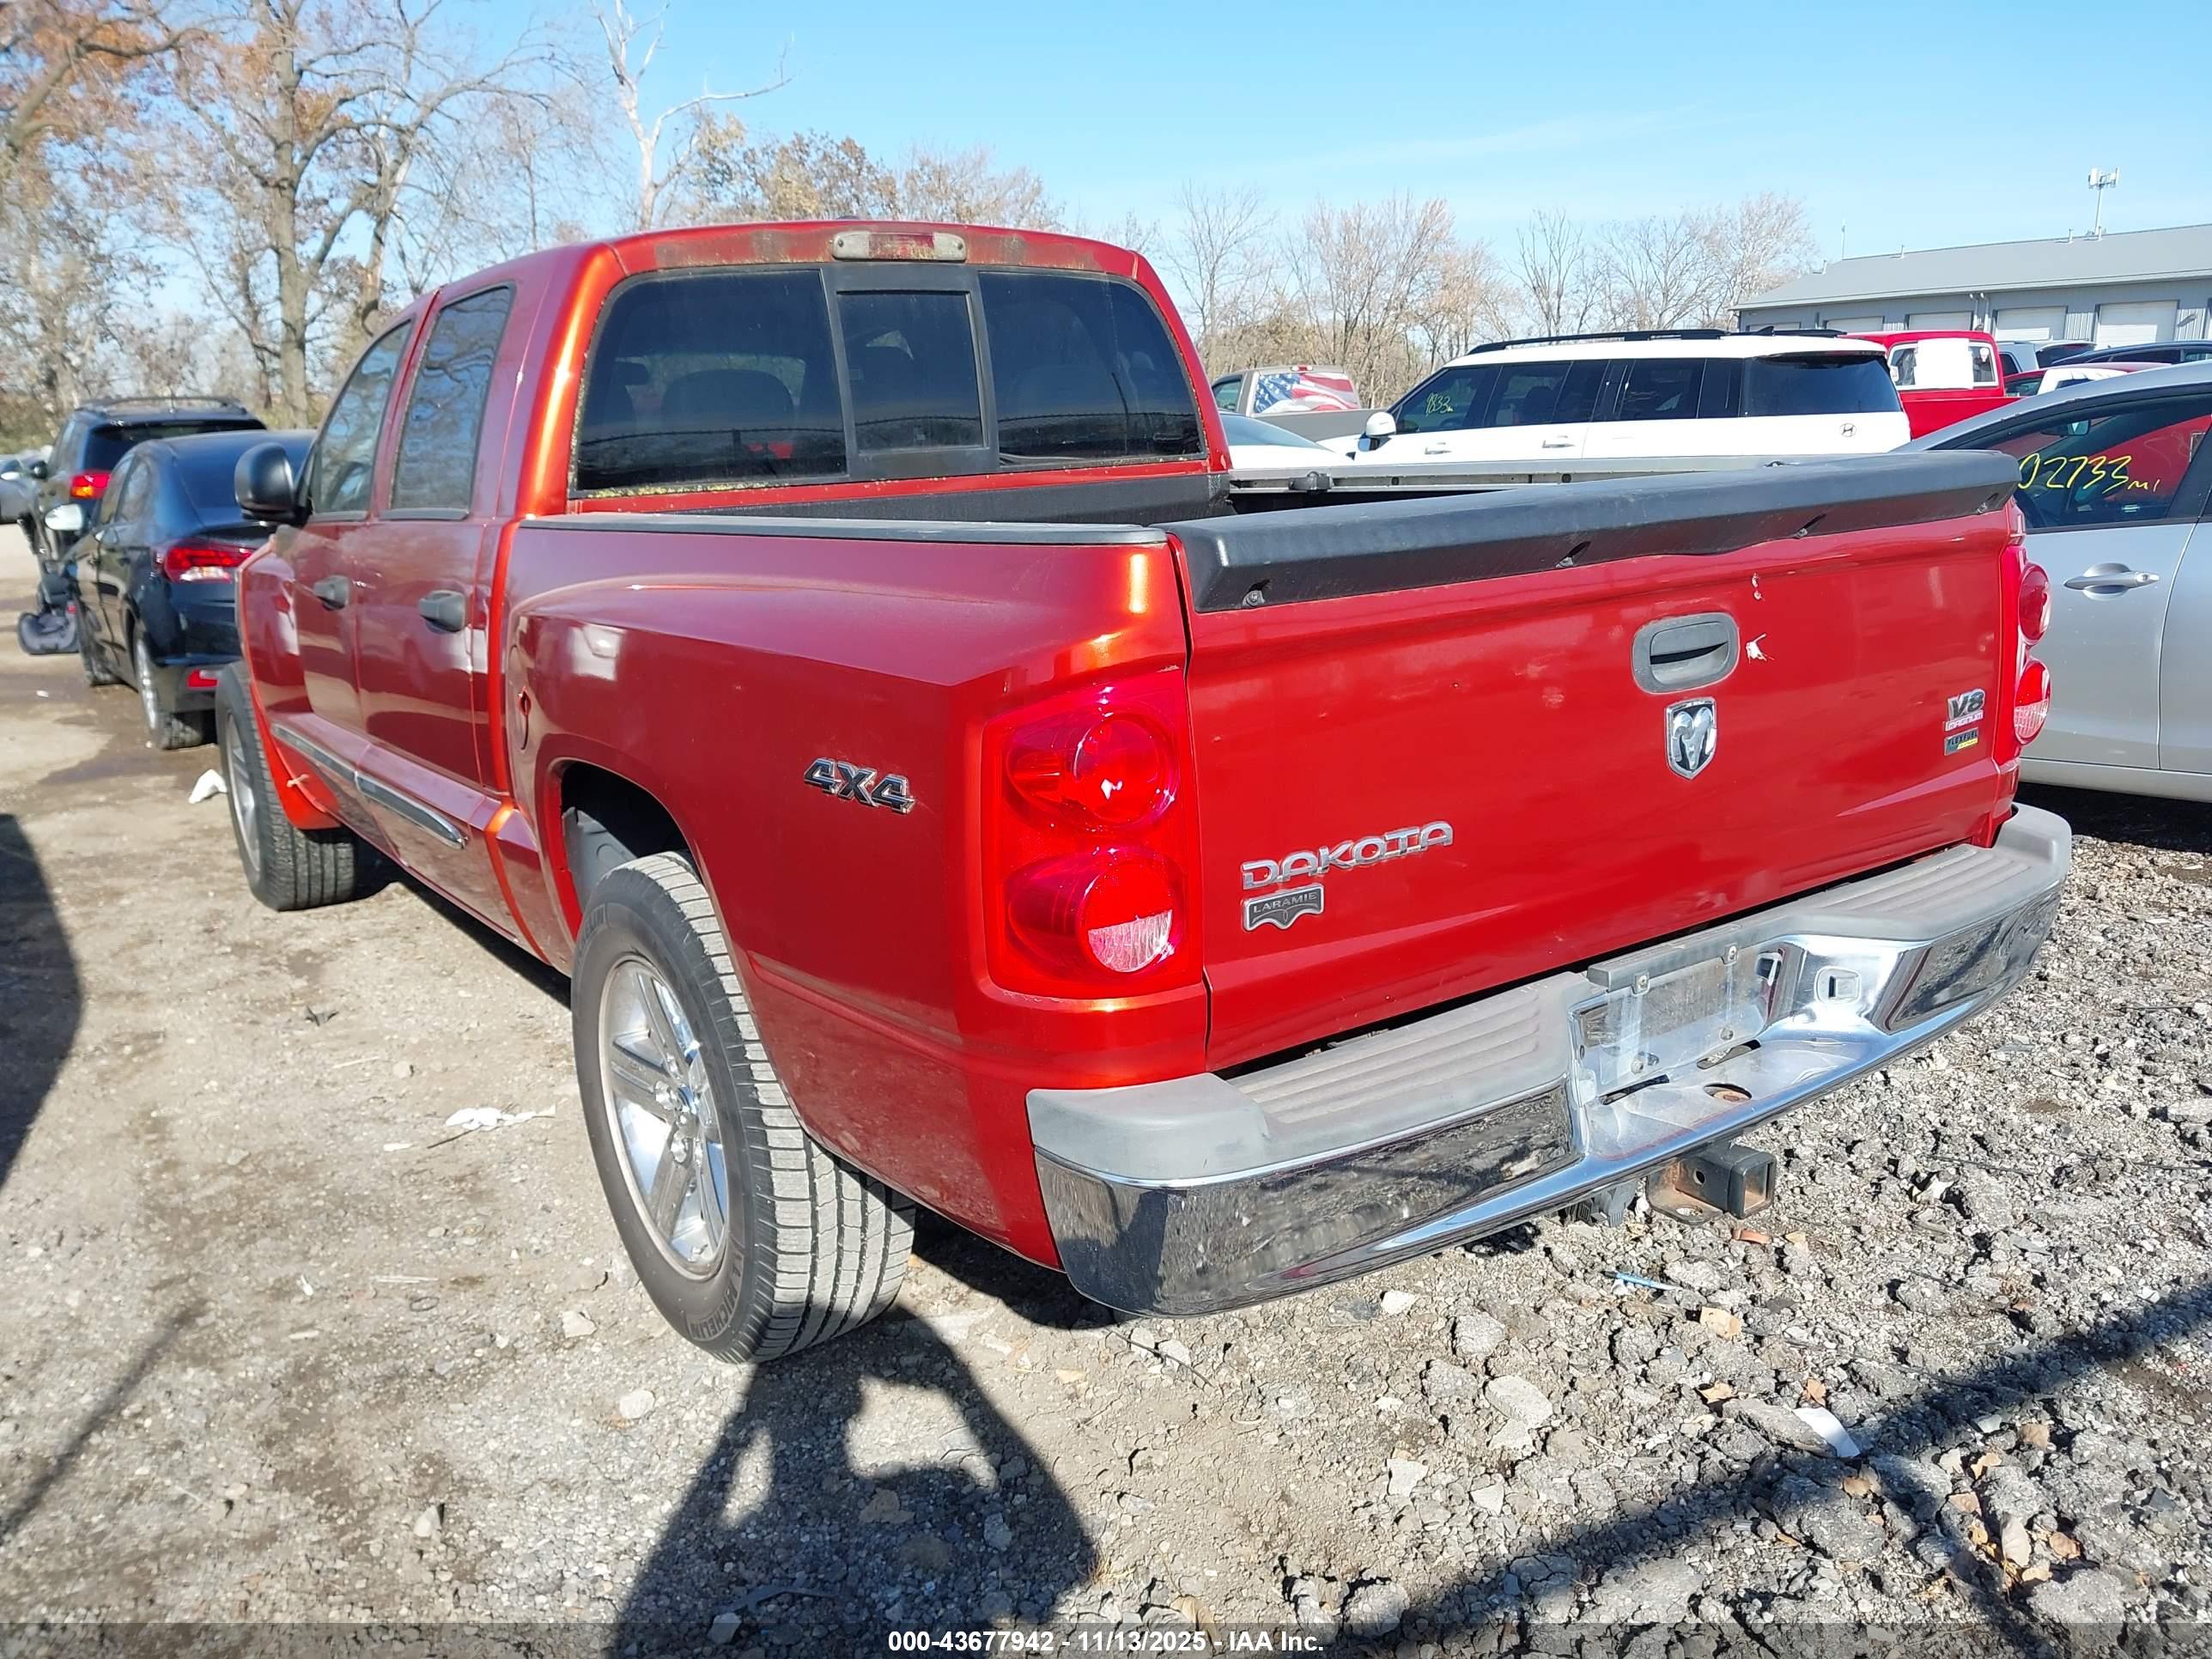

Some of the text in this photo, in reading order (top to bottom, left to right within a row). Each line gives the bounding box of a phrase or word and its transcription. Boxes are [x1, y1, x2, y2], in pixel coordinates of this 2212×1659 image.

[1948, 689, 1985, 720] V8
[1242, 820, 1454, 890] DAKOTA
[1253, 891, 1317, 914] LARAMIE
